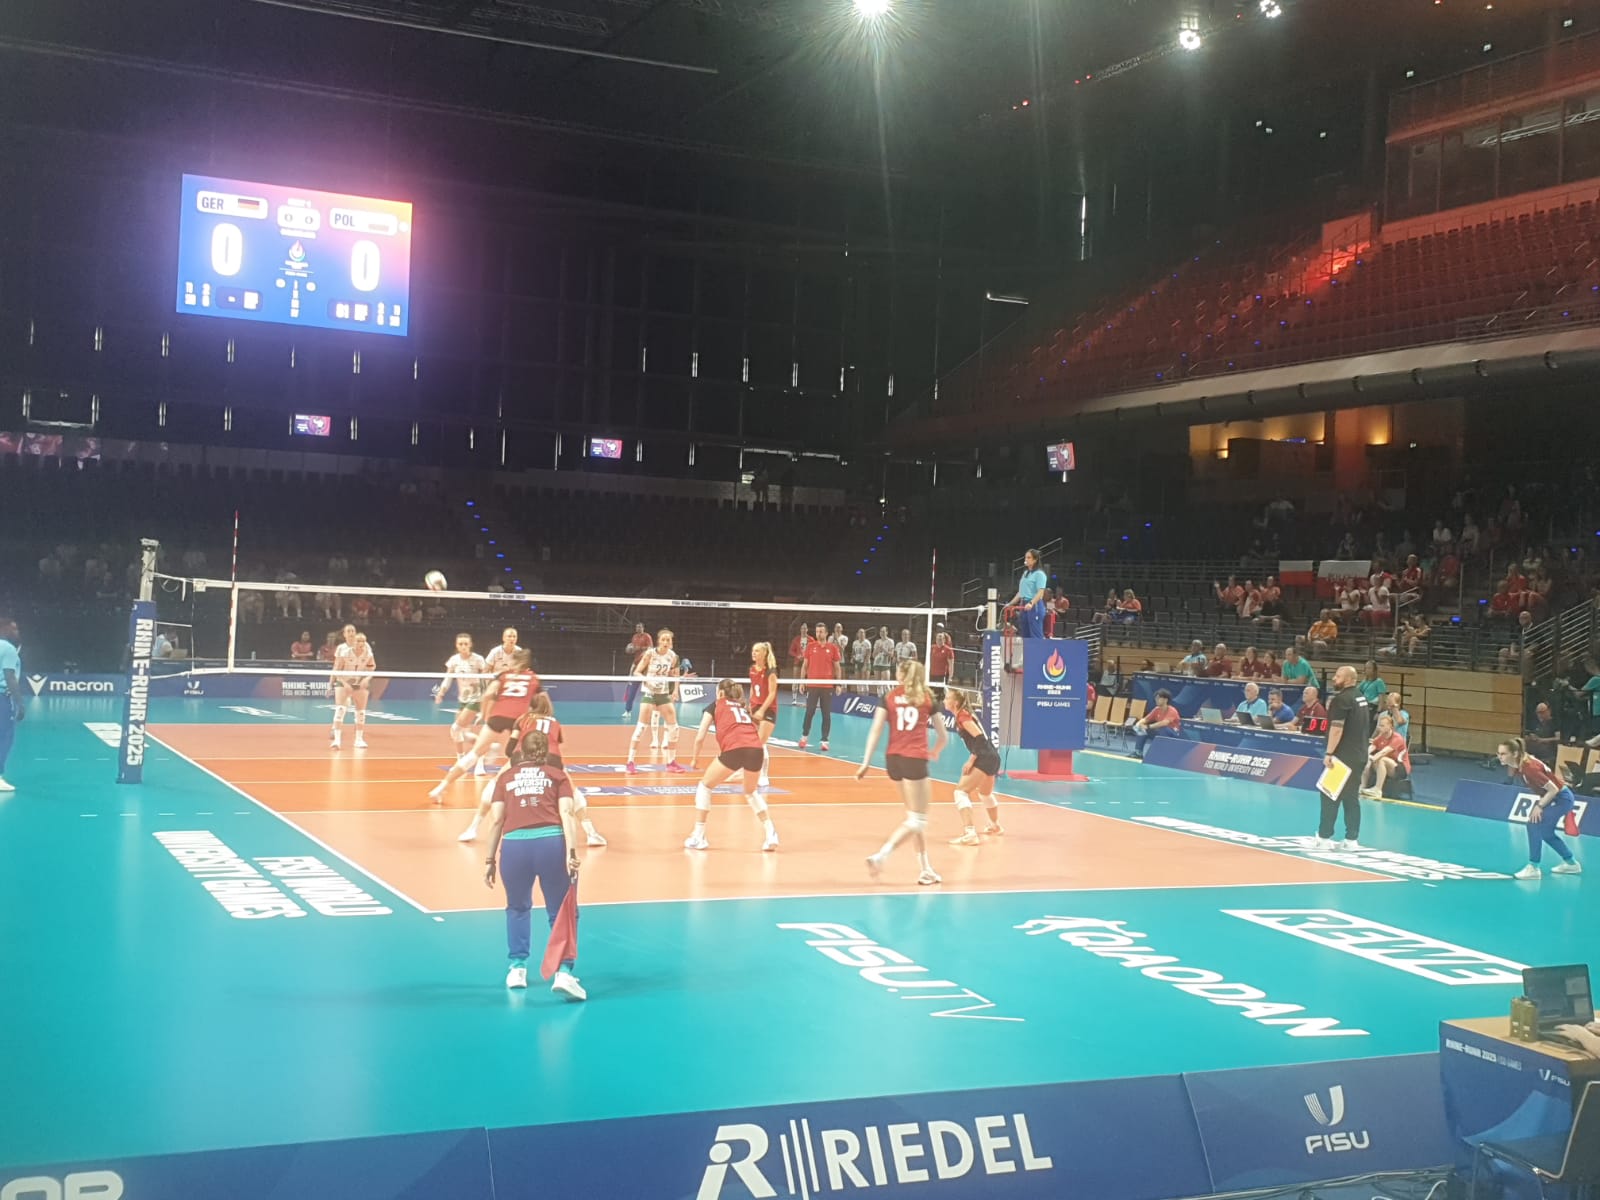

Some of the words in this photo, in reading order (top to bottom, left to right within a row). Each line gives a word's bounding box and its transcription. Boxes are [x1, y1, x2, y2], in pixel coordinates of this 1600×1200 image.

[201, 197, 224, 210] GER
[334, 213, 355, 227] POL
[211, 223, 243, 276] 0
[351, 240, 380, 291] 0
[129, 619, 154, 721] RHINE-RUHR
[656, 664, 669, 676] 22
[50, 680, 114, 692] macron
[730, 706, 752, 724] 15
[856, 702, 876, 714] FISU
[896, 706, 919, 731] 19
[126, 724, 145, 766] 2025
[1207, 750, 1252, 766] RHINE-RUHR
[1250, 755, 1272, 768] 2025
[201, 879, 308, 919] GAMES
[1250, 913, 1523, 978] REWE
[1058, 931, 1371, 1037] QIAODAN
[821, 1113, 1053, 1190] RIEDEL
[1305, 1130, 1370, 1155] FISU
